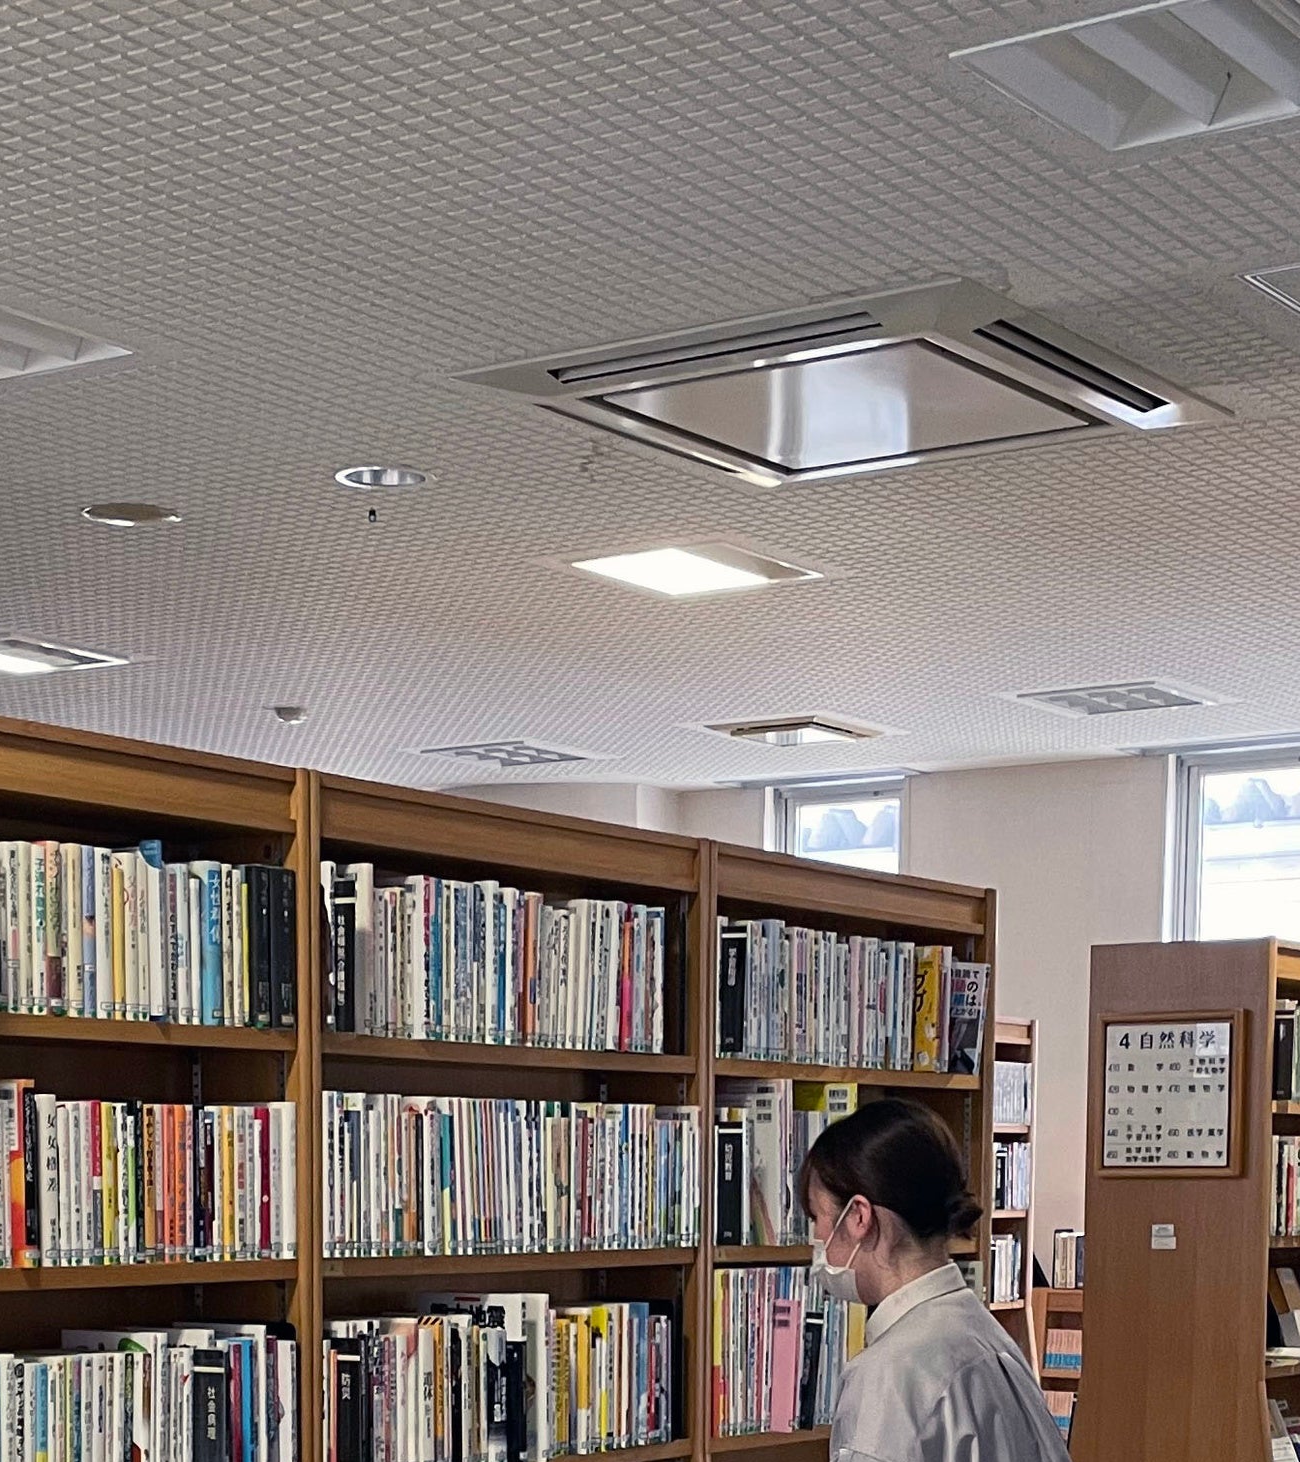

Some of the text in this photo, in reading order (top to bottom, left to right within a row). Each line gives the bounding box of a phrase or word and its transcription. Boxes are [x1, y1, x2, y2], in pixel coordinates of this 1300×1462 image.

[1118, 1030, 1216, 1050] 4 自然科学
